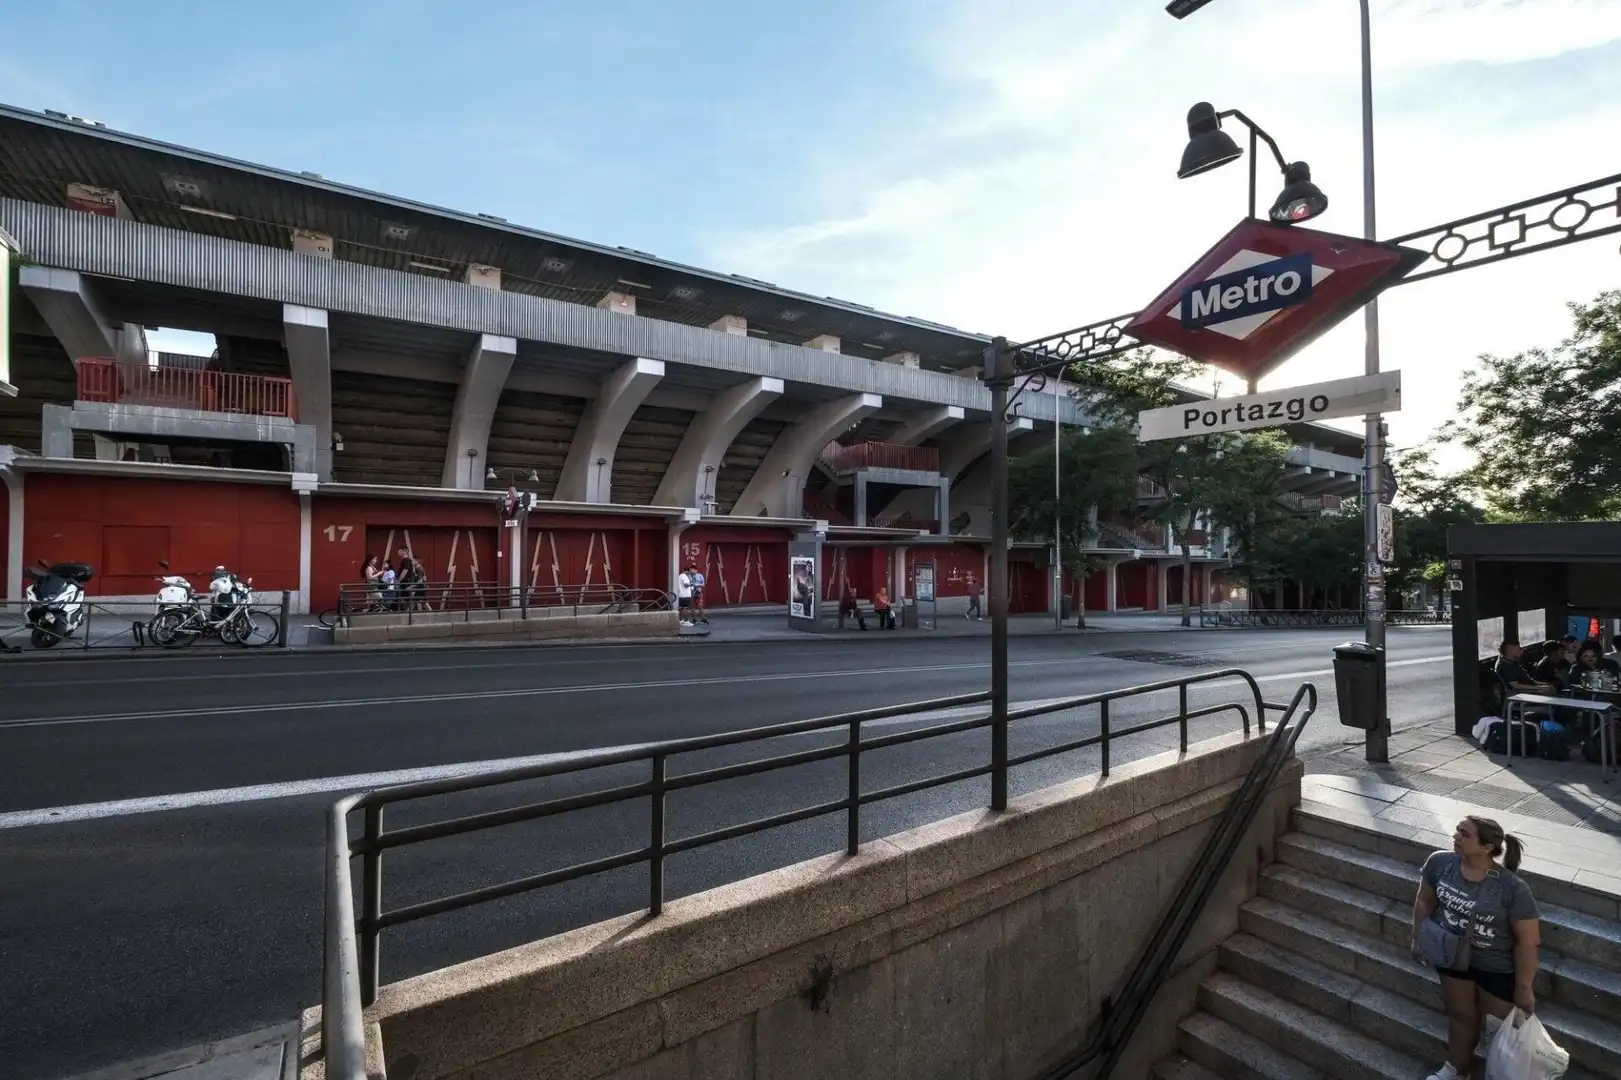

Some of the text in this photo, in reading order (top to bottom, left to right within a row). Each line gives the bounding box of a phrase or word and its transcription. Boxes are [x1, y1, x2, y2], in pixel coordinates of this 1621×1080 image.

[1191, 271, 1301, 319] Metro
[1184, 395, 1329, 430] Portazgo
[323, 525, 353, 542] 17
[682, 543, 700, 556] 15
